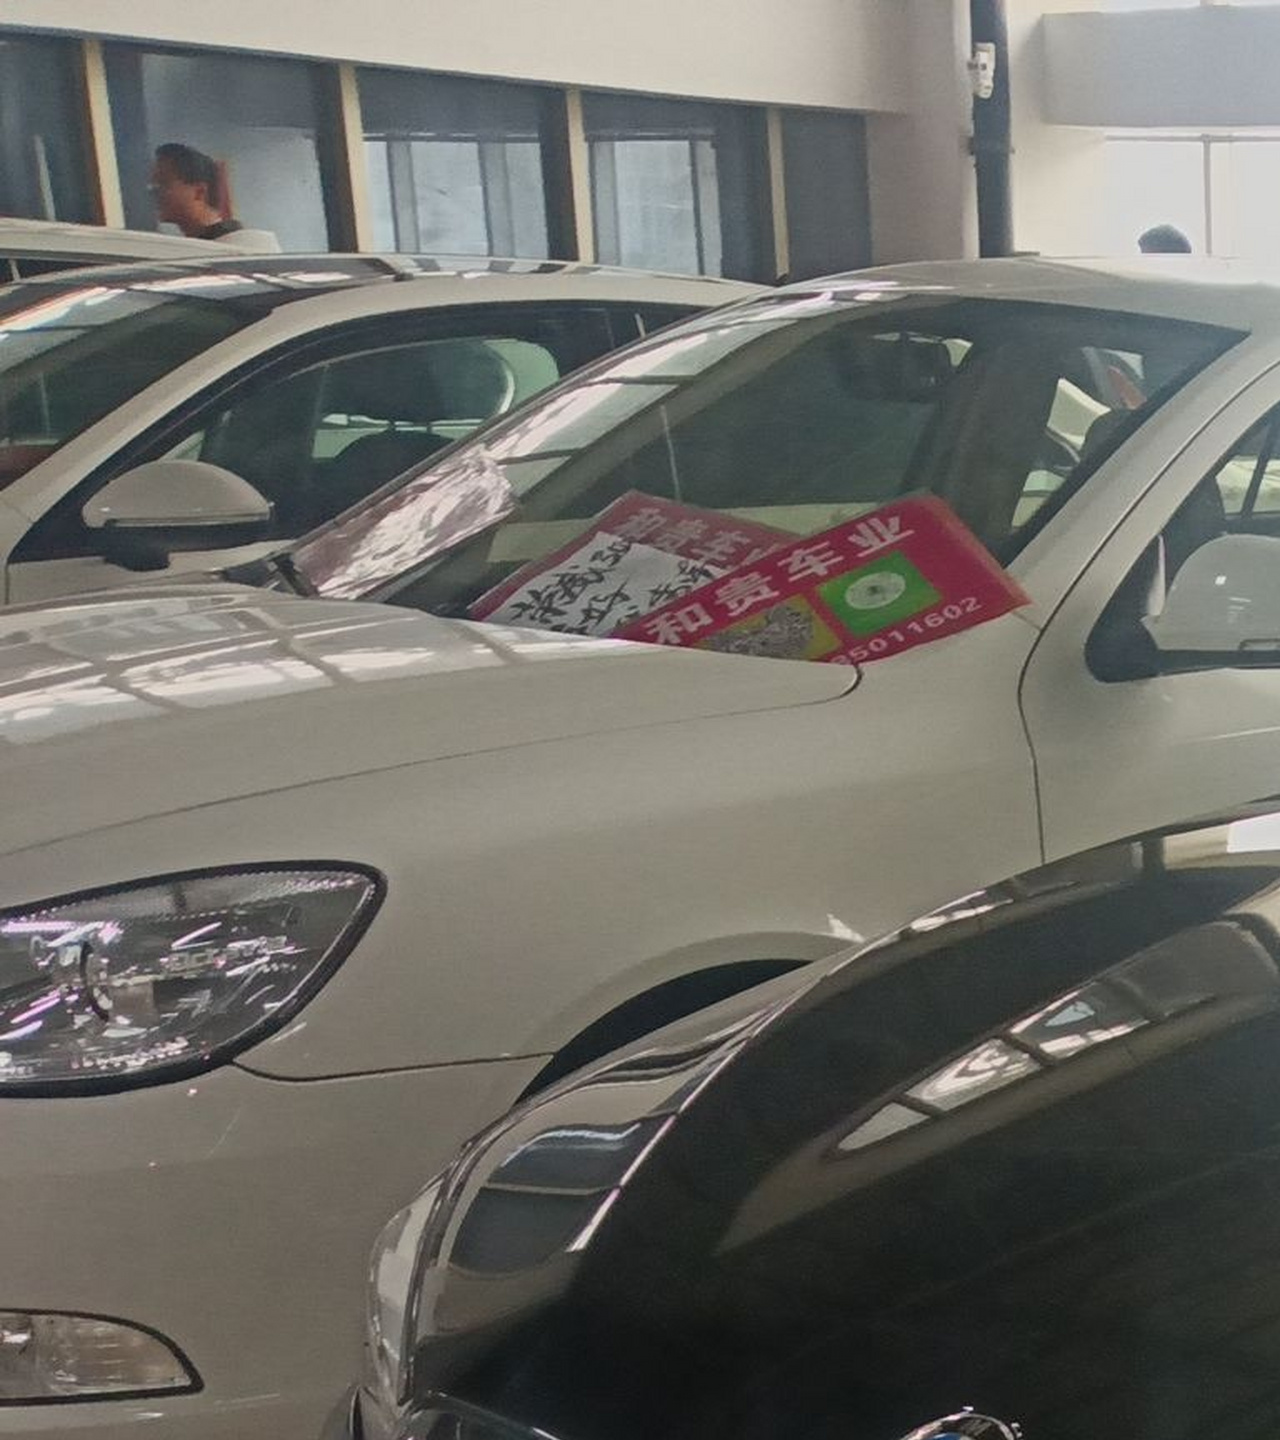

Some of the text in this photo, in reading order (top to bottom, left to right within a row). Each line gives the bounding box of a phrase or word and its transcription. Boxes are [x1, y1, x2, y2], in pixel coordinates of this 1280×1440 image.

[613, 508, 787, 567] 和贵车
[646, 514, 914, 645] 和贵车业
